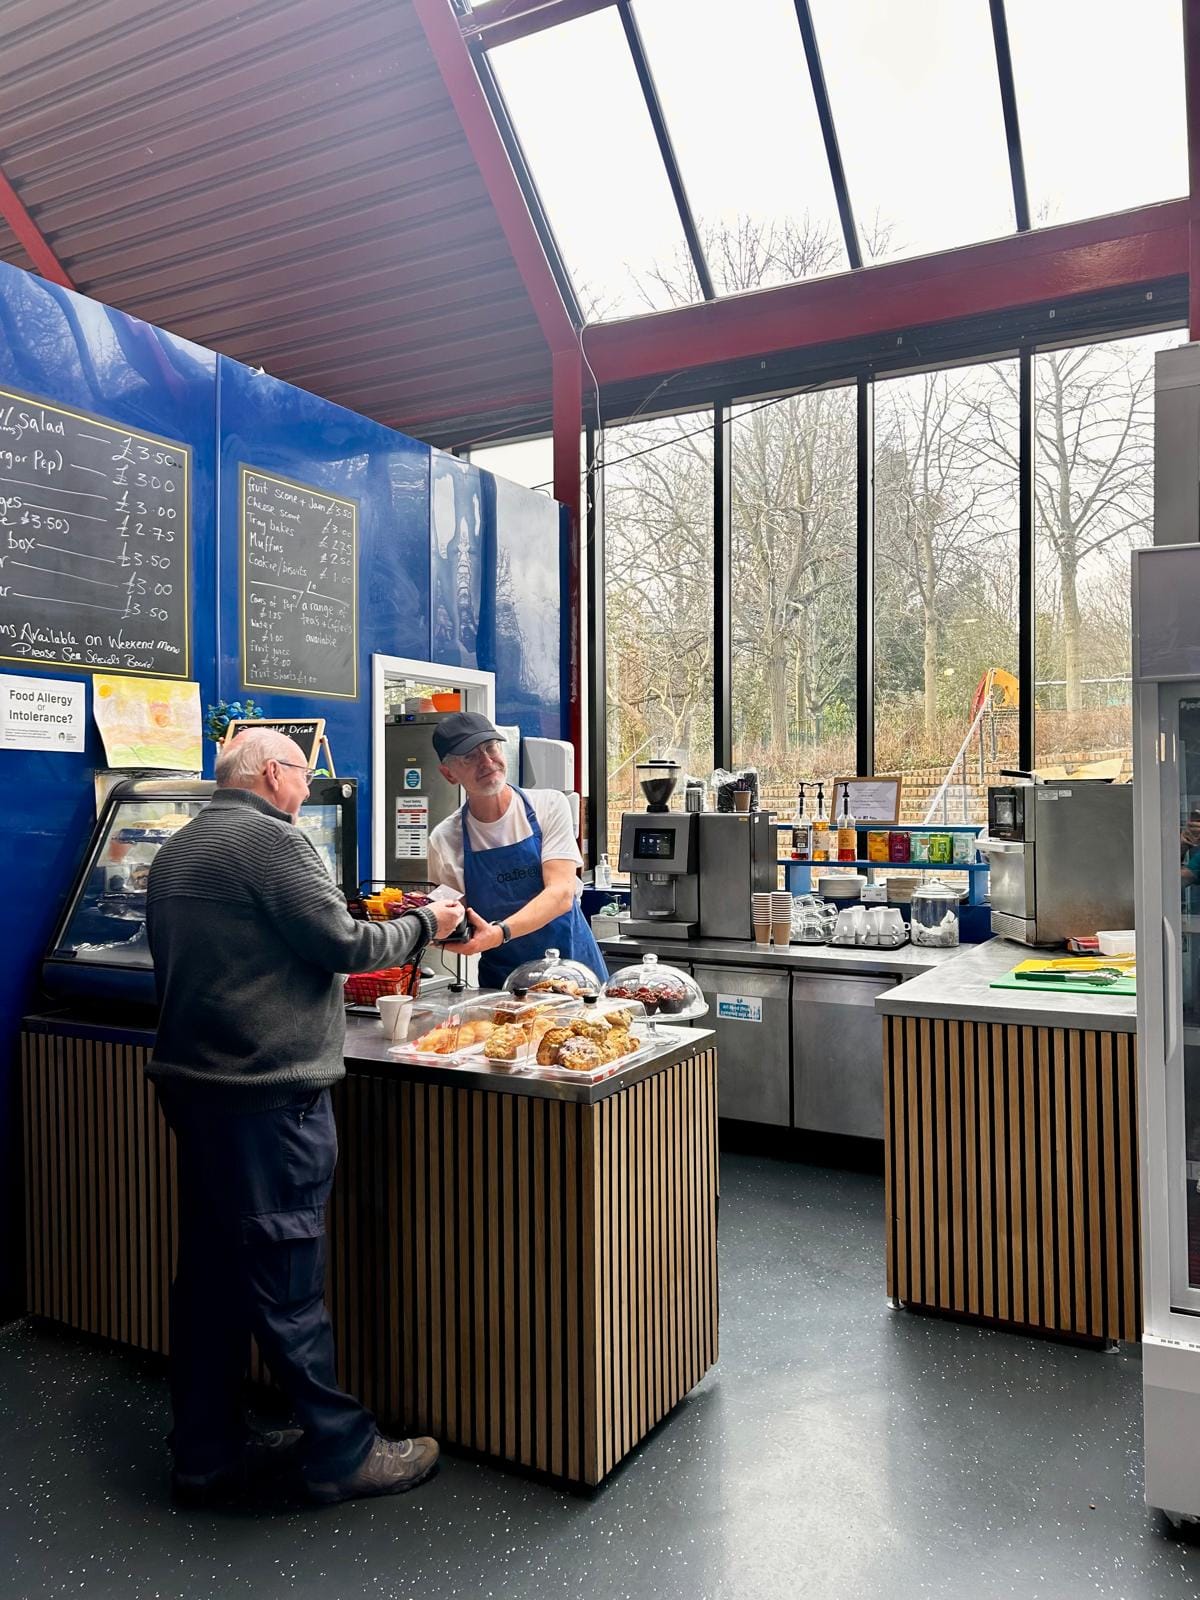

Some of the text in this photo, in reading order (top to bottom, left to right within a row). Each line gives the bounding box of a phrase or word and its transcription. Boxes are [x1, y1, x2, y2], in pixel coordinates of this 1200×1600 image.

[19, 410, 65, 436] Salad
[308, 497, 326, 512] Jam
[7, 530, 36, 553] box
[20, 622, 79, 645] Available
[85, 634, 103, 646] on
[108, 628, 155, 650] Weekend
[11, 642, 57, 660] Please
[9, 689, 73, 707] Food Allergy
[9, 709, 73, 724] Intolerance?
